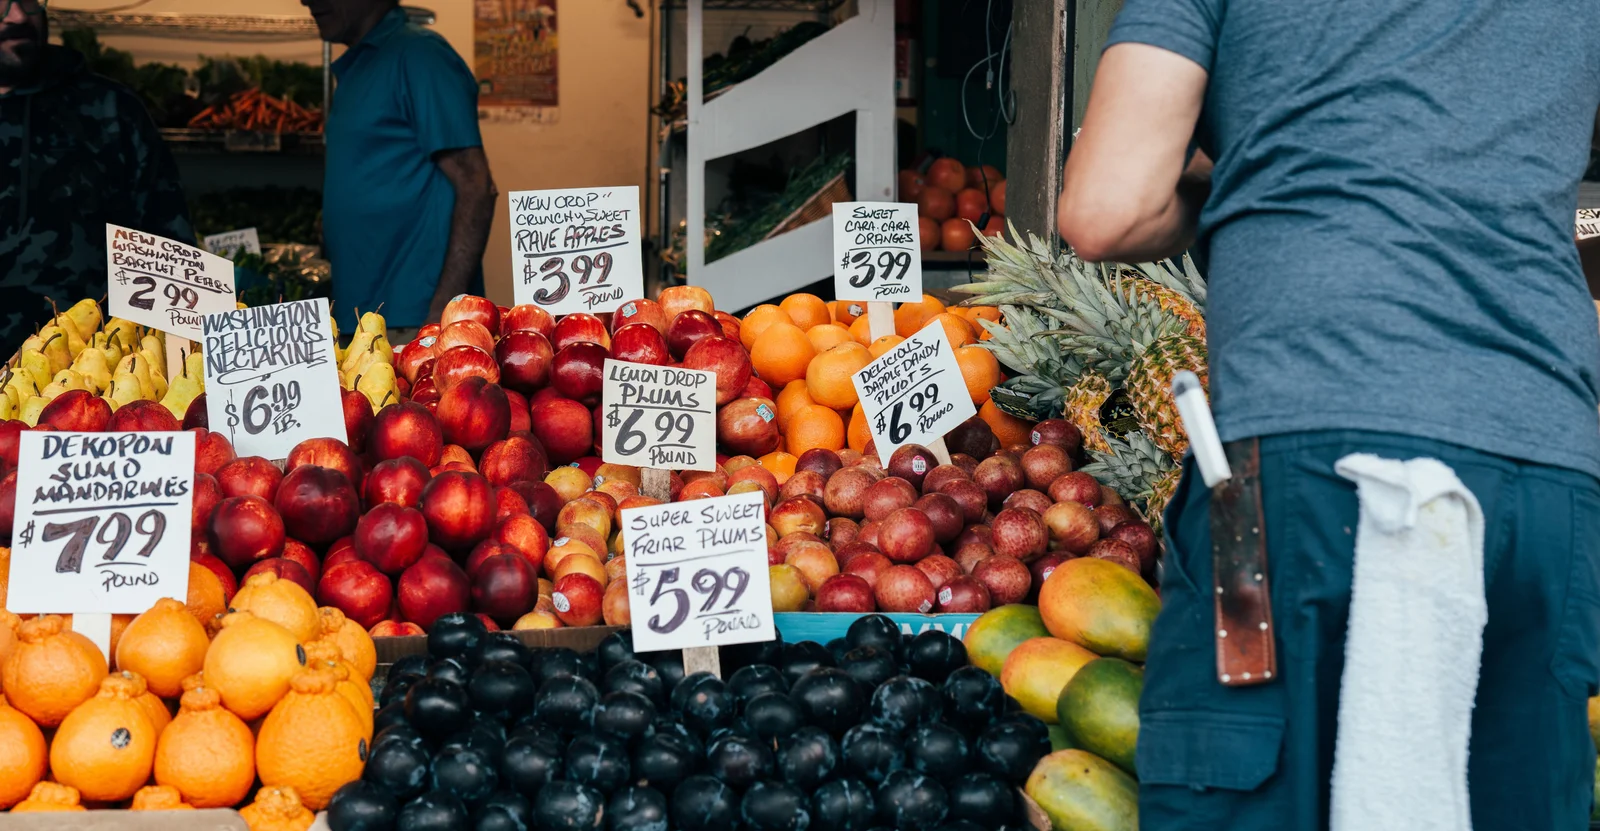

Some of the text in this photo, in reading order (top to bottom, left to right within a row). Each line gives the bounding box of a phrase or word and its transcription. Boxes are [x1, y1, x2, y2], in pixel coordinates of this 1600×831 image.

[584, 208, 631, 222] SWEET
[852, 206, 899, 220] SWEET
[114, 229, 155, 246] NEW
[160, 242, 202, 259] CROP
[515, 224, 625, 252] RAVE APPLES
[855, 232, 914, 245] ORANGES
[112, 240, 205, 271] WASHINGTON
[113, 253, 234, 294] BARTLET PEARS
[583, 287, 624, 310] POUND
[873, 285, 910, 299] POUND
[166, 308, 202, 326] POUN
[201, 300, 321, 336] WASHINGTON
[206, 322, 327, 356] DELICIOUS
[206, 342, 327, 378] NECTARINE
[859, 338, 923, 384] DELICIOUS
[863, 339, 940, 397] DAPPLE DANDY
[609, 365, 707, 389] LEMON DROP
[619, 383, 700, 408] PLUMS
[916, 402, 954, 433] POUND
[41, 433, 174, 460] DEKOPON
[649, 444, 697, 466] POUND
[49, 458, 141, 482] SUMO
[631, 503, 764, 531] SUPER SWEET
[631, 526, 764, 558] FRIAR PLUMS
[100, 569, 160, 592] POUND
[702, 613, 762, 640] POUND
